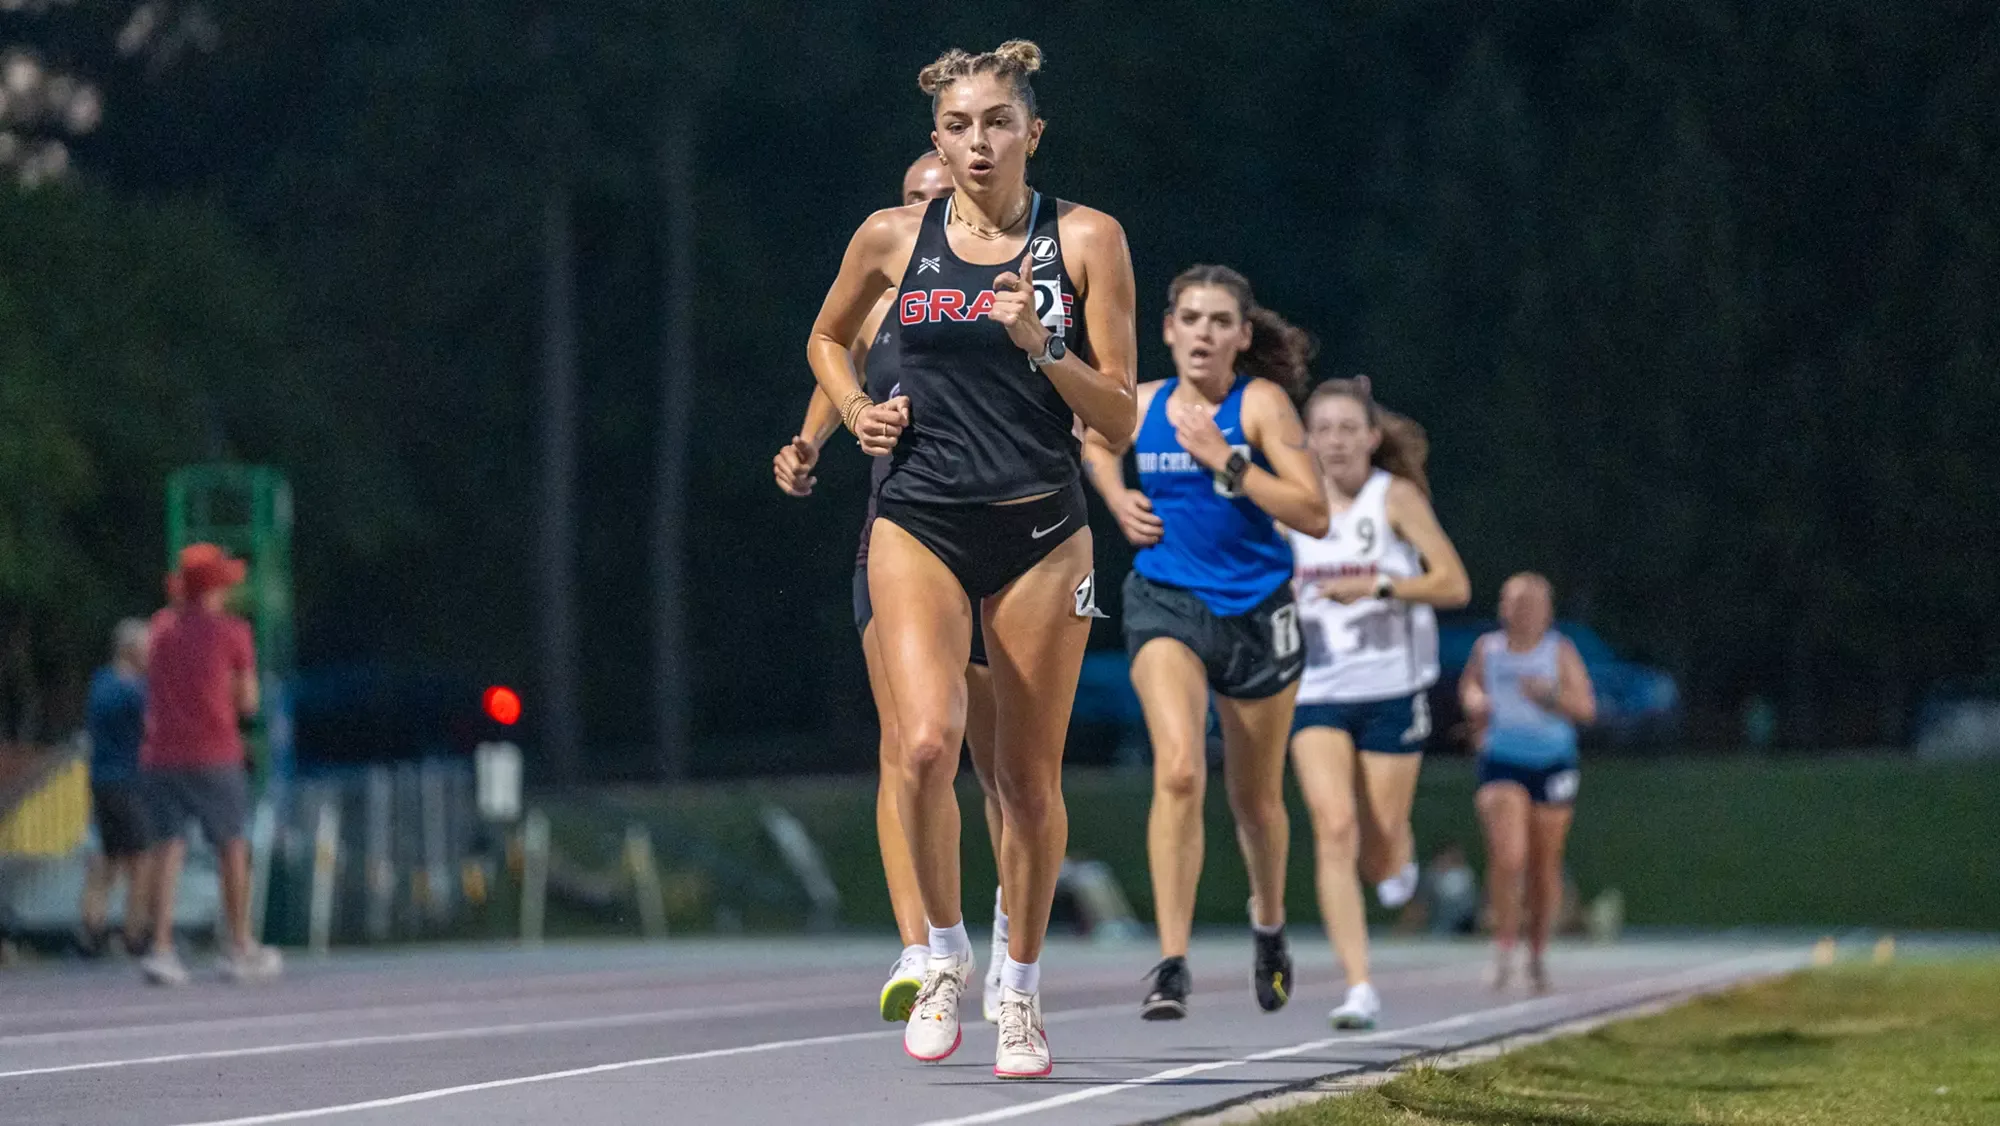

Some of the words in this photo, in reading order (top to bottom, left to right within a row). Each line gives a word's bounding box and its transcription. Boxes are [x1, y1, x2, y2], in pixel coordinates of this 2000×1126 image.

[900, 288, 1073, 326] GRAE
[1356, 517, 1376, 555] 9
[1278, 609, 1291, 651] 7
